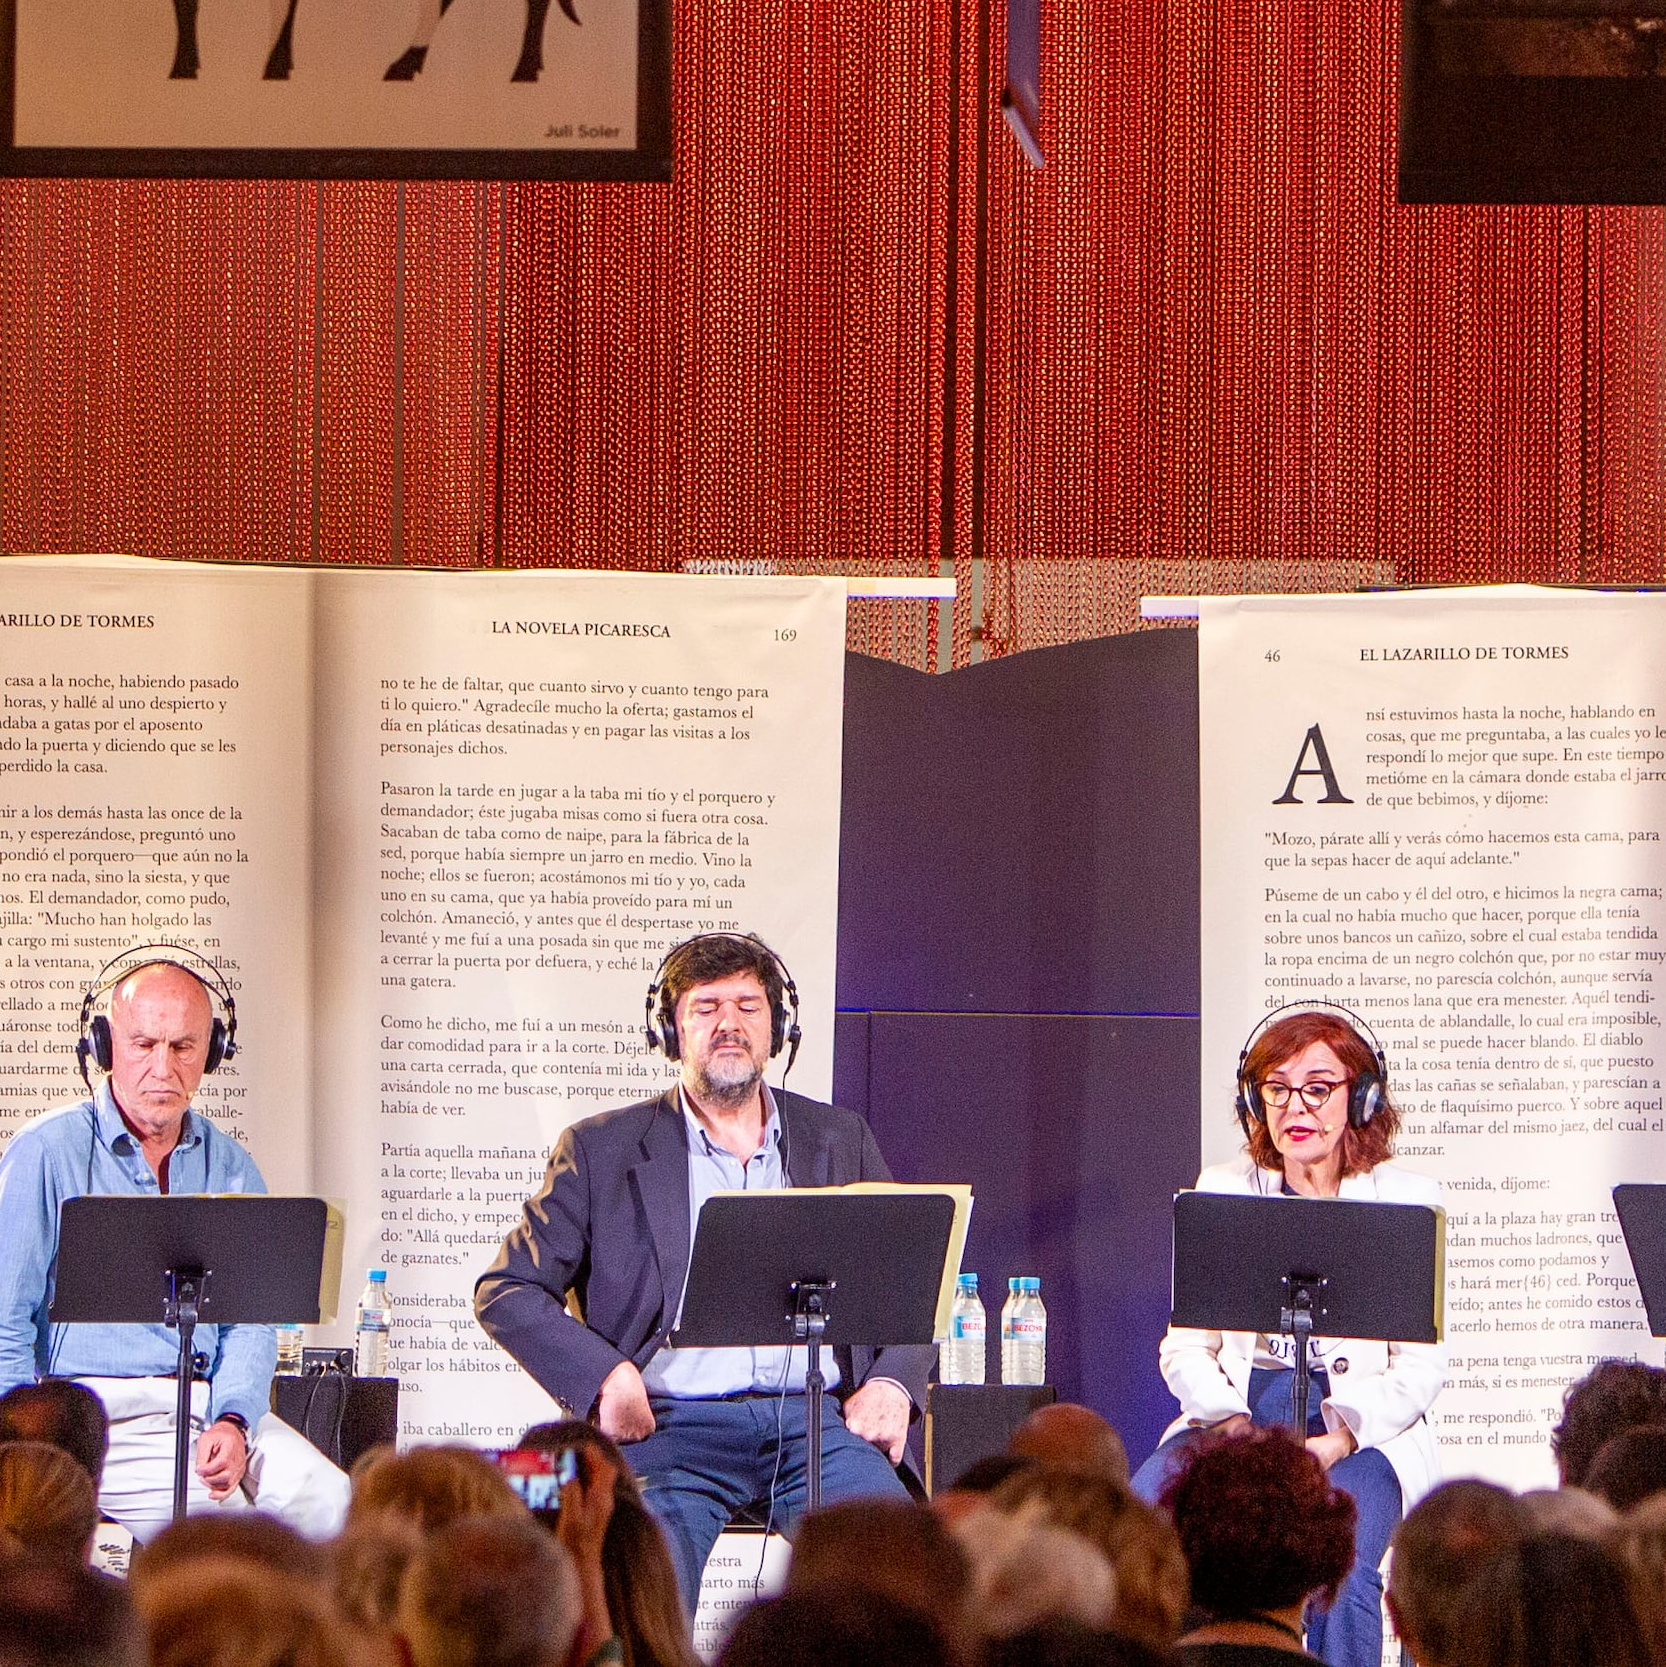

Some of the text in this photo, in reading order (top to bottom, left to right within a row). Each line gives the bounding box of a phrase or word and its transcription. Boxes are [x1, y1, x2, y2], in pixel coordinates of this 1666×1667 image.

[579, 124, 620, 138] Soler
[60, 614, 82, 627] DE
[86, 615, 154, 628] TORMES
[492, 621, 671, 638] LA NOVELA PICARESCA
[775, 628, 797, 642] 169
[1264, 649, 1281, 663] 46
[1360, 646, 1569, 661] EL LAZARILLO DE TORMES
[5, 677, 34, 687] casa
[39, 678, 47, 687] a
[52, 673, 64, 687] la
[68, 674, 115, 690] noche,
[119, 674, 185, 688] habiendo
[190, 675, 239, 693] pasado
[381, 676, 769, 702] no te he de faltar, que cuanto sirvo y cuanto tengo para
[1366, 704, 1655, 721] nsí estuvimos hasta la noche, hablando en
[380, 740, 507, 758] personajes dichos.
[380, 802, 768, 825] demandador; éste jugaba misas como si fuera otra cosa.
[1265, 830, 1660, 850] "Mozo, párate allí y verás cómo hacemos esta cama, para
[29, 890, 44, 904] El
[48, 890, 141, 906] demandador,
[146, 895, 186, 905] como
[190, 891, 230, 909] pudo,
[1264, 969, 1653, 989] continuado a lavarse, no parescía colchón, aunque servía
[42, 1087, 68, 1101] que
[380, 1080, 614, 1100] avisándole no me buscase, porque
[1447, 1176, 1550, 1194] venida, díjome:
